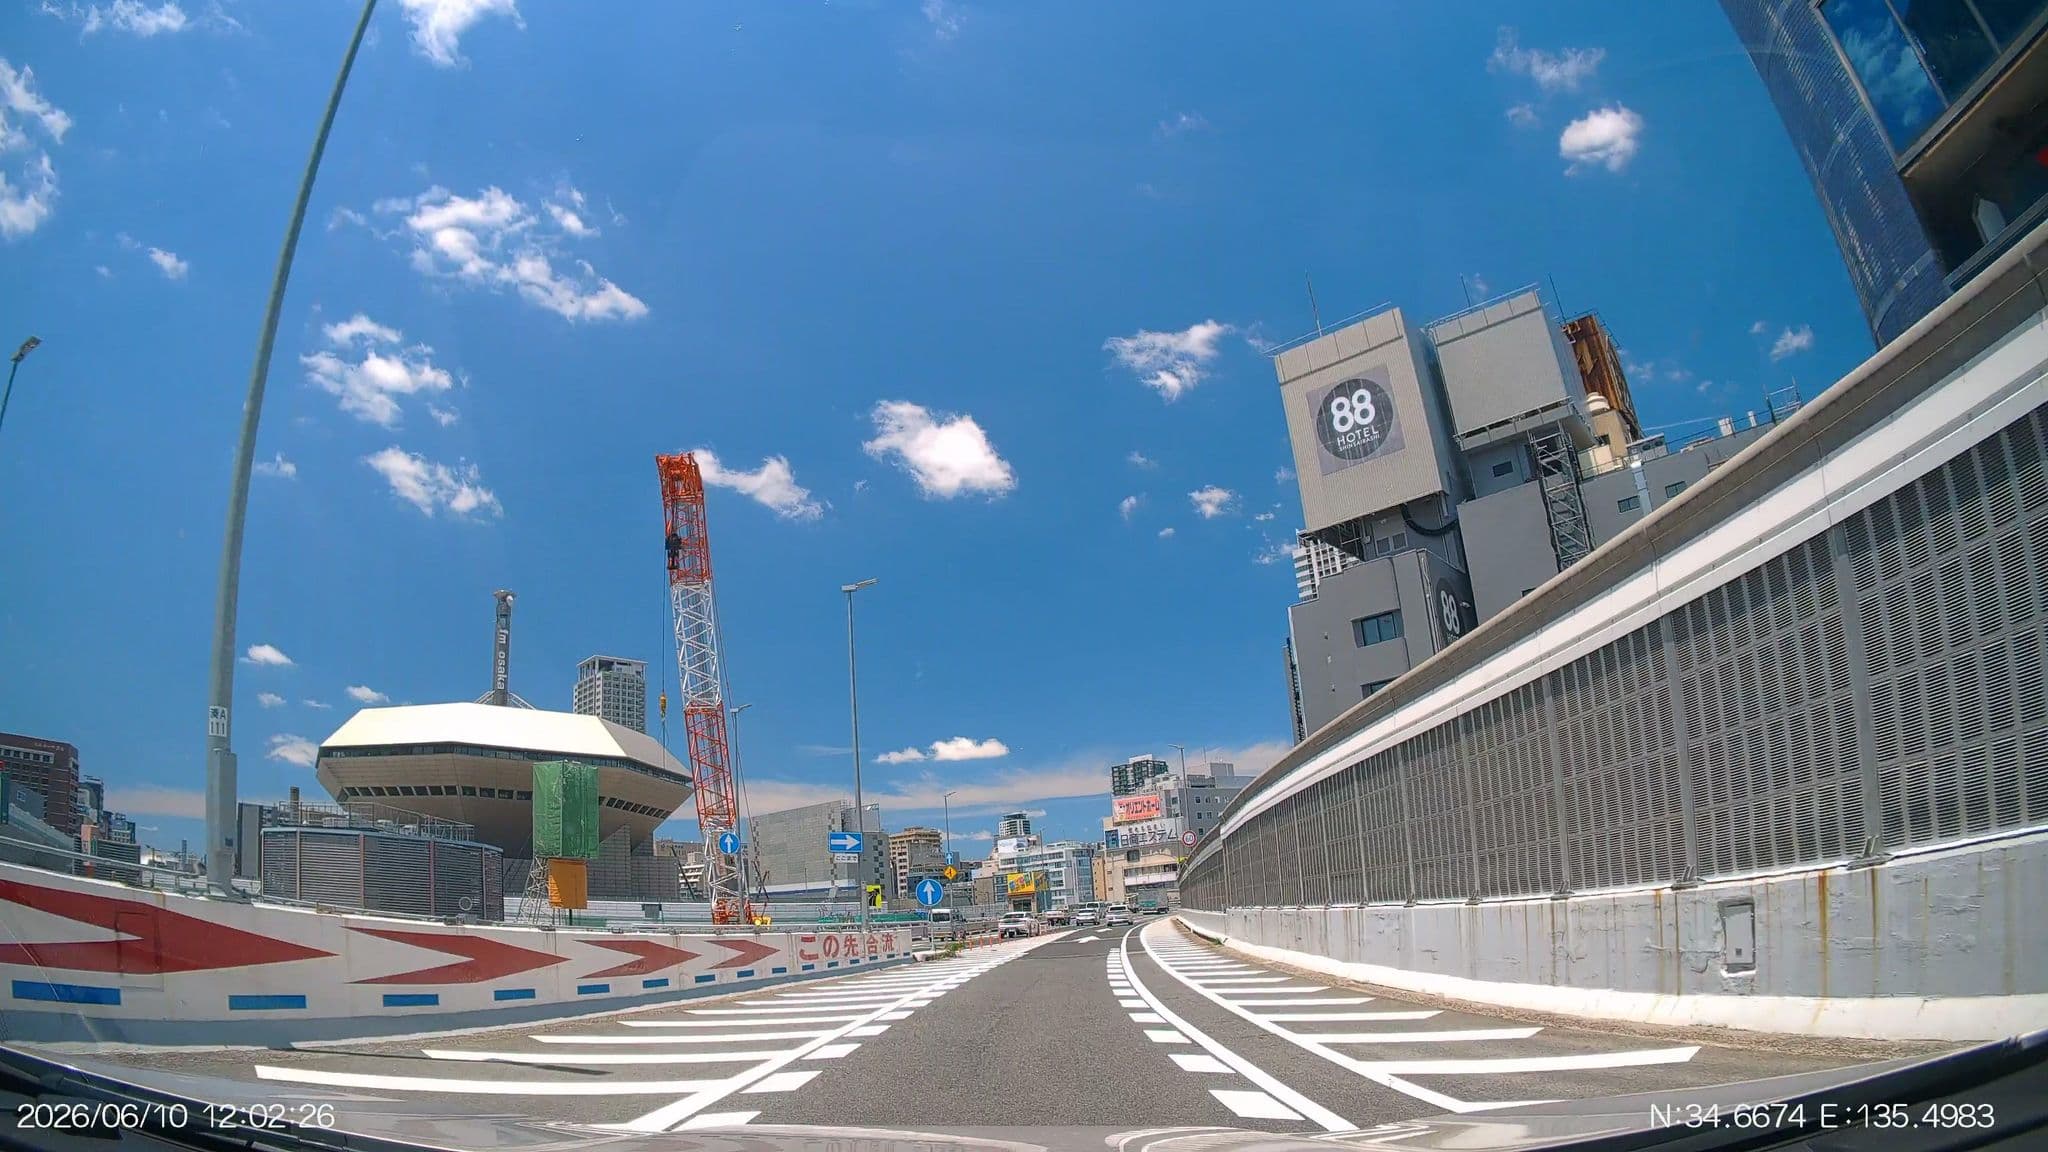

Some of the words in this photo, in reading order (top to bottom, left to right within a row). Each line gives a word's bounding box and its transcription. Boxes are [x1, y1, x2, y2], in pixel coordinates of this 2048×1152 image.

[1330, 388, 1376, 433] 88
[1336, 425, 1380, 447] HOTEL
[1338, 433, 1381, 453] SHINSAIBASHI
[1440, 590, 1460, 635] 88
[498, 628, 509, 645] fm
[497, 651, 508, 691] osaka
[1120, 827, 1179, 848] 日商エステム
[799, 931, 898, 962] この先合流
